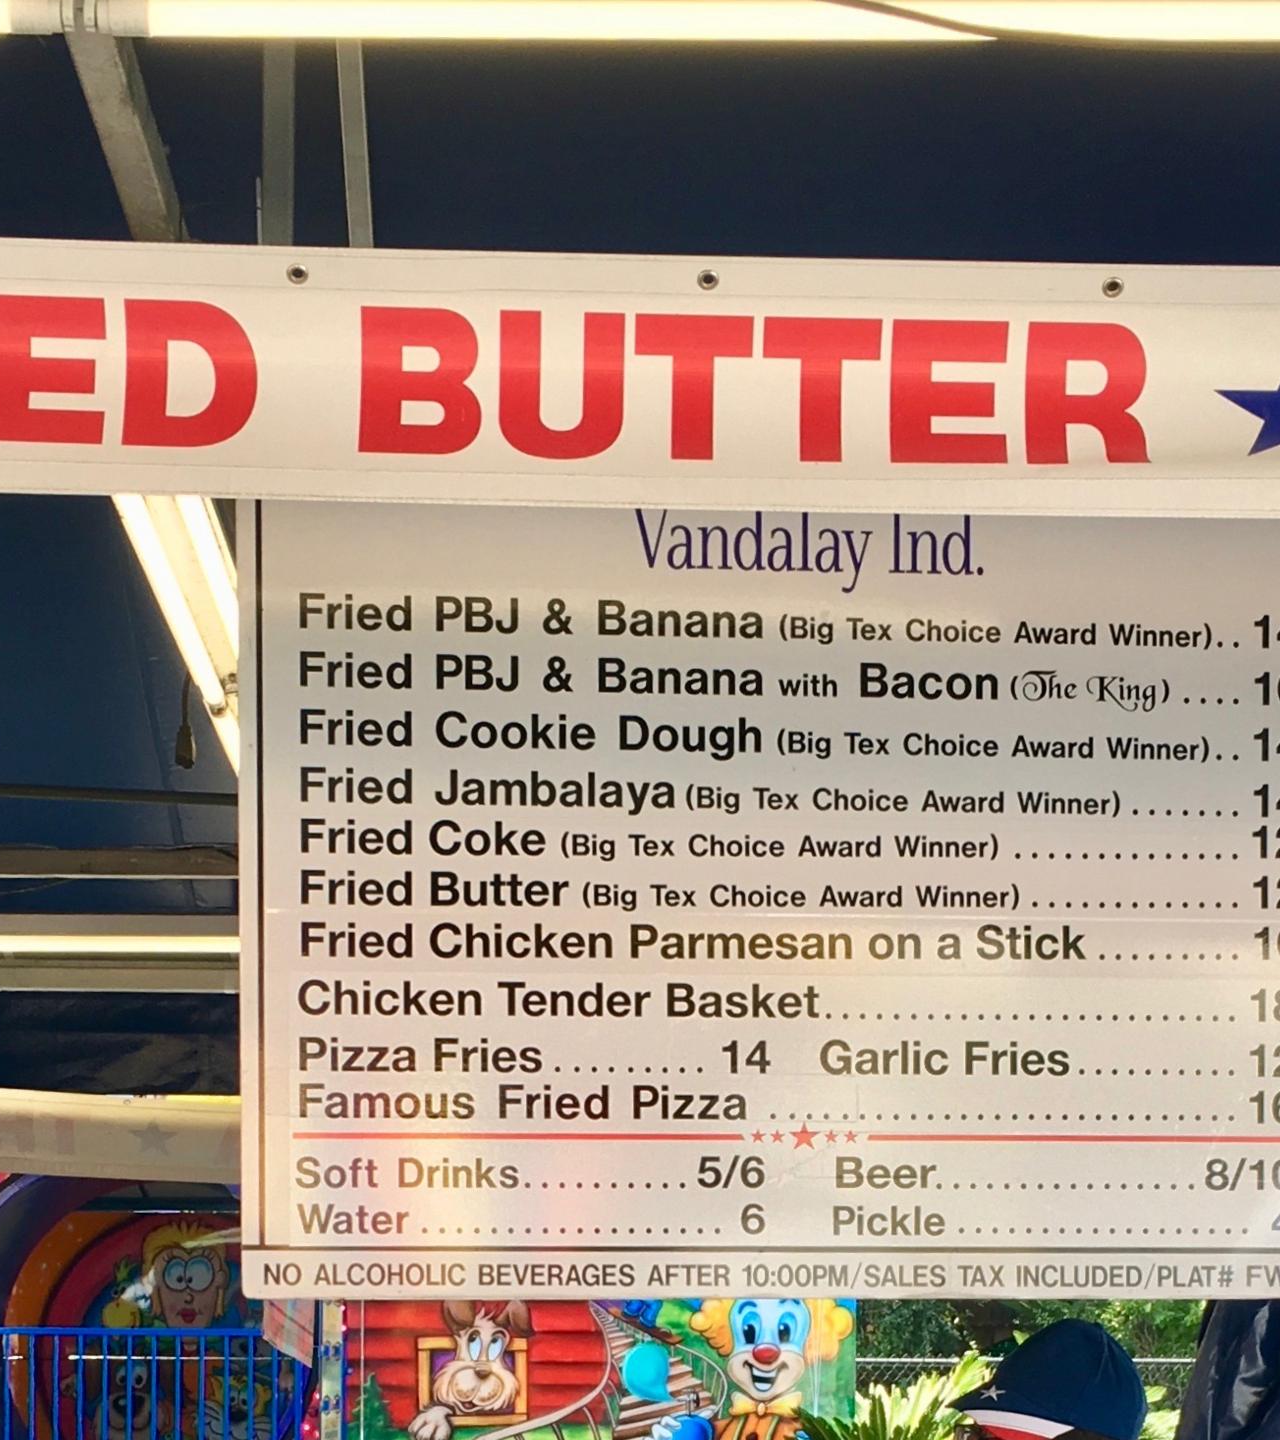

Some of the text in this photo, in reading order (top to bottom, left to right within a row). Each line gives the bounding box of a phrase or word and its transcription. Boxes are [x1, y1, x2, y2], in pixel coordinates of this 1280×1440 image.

[357, 305, 1152, 465] BUTTER
[635, 508, 985, 593] Vandalay Ind.
[299, 592, 412, 632] Fried
[435, 595, 519, 635] PBJ
[542, 598, 574, 636] &
[597, 599, 763, 640] Banana
[779, 613, 834, 645] (Big
[846, 617, 892, 641] Tex
[905, 618, 1002, 644] Choice
[1013, 621, 1097, 646] Award
[1108, 622, 1212, 650] Winner)
[299, 650, 412, 690] Fried
[436, 653, 519, 692] PBJ
[542, 655, 574, 693] &
[598, 657, 763, 697] Banana
[778, 673, 838, 698] with
[860, 662, 999, 701] Bacon
[1010, 670, 1077, 701] (The
[1086, 676, 1170, 713] King)
[300, 708, 413, 747] Fried
[435, 710, 596, 751] Cookie
[619, 714, 762, 762] Dough
[777, 728, 831, 760] (Big
[843, 732, 890, 755] Tex
[903, 732, 999, 757] Choice
[1011, 735, 1094, 759] Award
[1106, 736, 1210, 763] Winner)
[300, 766, 413, 805] Fried
[434, 768, 675, 816] Jambalaya
[685, 783, 740, 815] (Big
[752, 787, 799, 810] Tex
[812, 787, 909, 812] Choice
[921, 789, 1005, 814] Award
[1017, 790, 1121, 818] Winner)
[300, 818, 413, 856] Fried
[429, 819, 546, 857] Coke
[560, 831, 616, 862] (Big
[628, 834, 675, 857] Tex
[688, 833, 785, 858] Choice
[798, 835, 881, 858] Award
[894, 833, 999, 861] Winner)
[300, 869, 413, 907] Fried
[430, 871, 570, 907] Butter
[582, 881, 637, 912] (Big
[649, 884, 696, 907] Tex
[709, 884, 806, 908] Choice
[819, 885, 903, 908] Award
[915, 883, 1020, 911] Winner)
[301, 921, 413, 959] Fried
[429, 922, 613, 959] Chicken
[630, 923, 852, 960] Parmesan
[868, 933, 922, 961] on
[937, 933, 961, 960] a
[977, 924, 1086, 961] Stick
[298, 979, 482, 1017] Chicken
[497, 981, 651, 1018] Tender
[666, 982, 820, 1019] Basket
[299, 1036, 771, 1074] Pizza Fries 14
[819, 1039, 949, 1076] Garlic
[965, 1041, 1070, 1077] Fries
[299, 1083, 475, 1120] Famous
[499, 1084, 609, 1120] Fried
[633, 1084, 746, 1120] Pizza
[295, 1155, 765, 1189] Soft Drinks 5/6
[835, 1156, 937, 1189] Beer
[297, 1203, 766, 1235] Water 6
[832, 1205, 946, 1237] Pickle
[263, 1263, 302, 1286] NO
[313, 1262, 466, 1287] ALCOHOLIC
[478, 1263, 635, 1287] BEVERAGES
[647, 1264, 730, 1287] AFTER
[742, 1262, 947, 1289] 10:00PM/SALES
[957, 1264, 1005, 1287] TAX
[1016, 1263, 1234, 1290] INCLUDED/PLAT#
